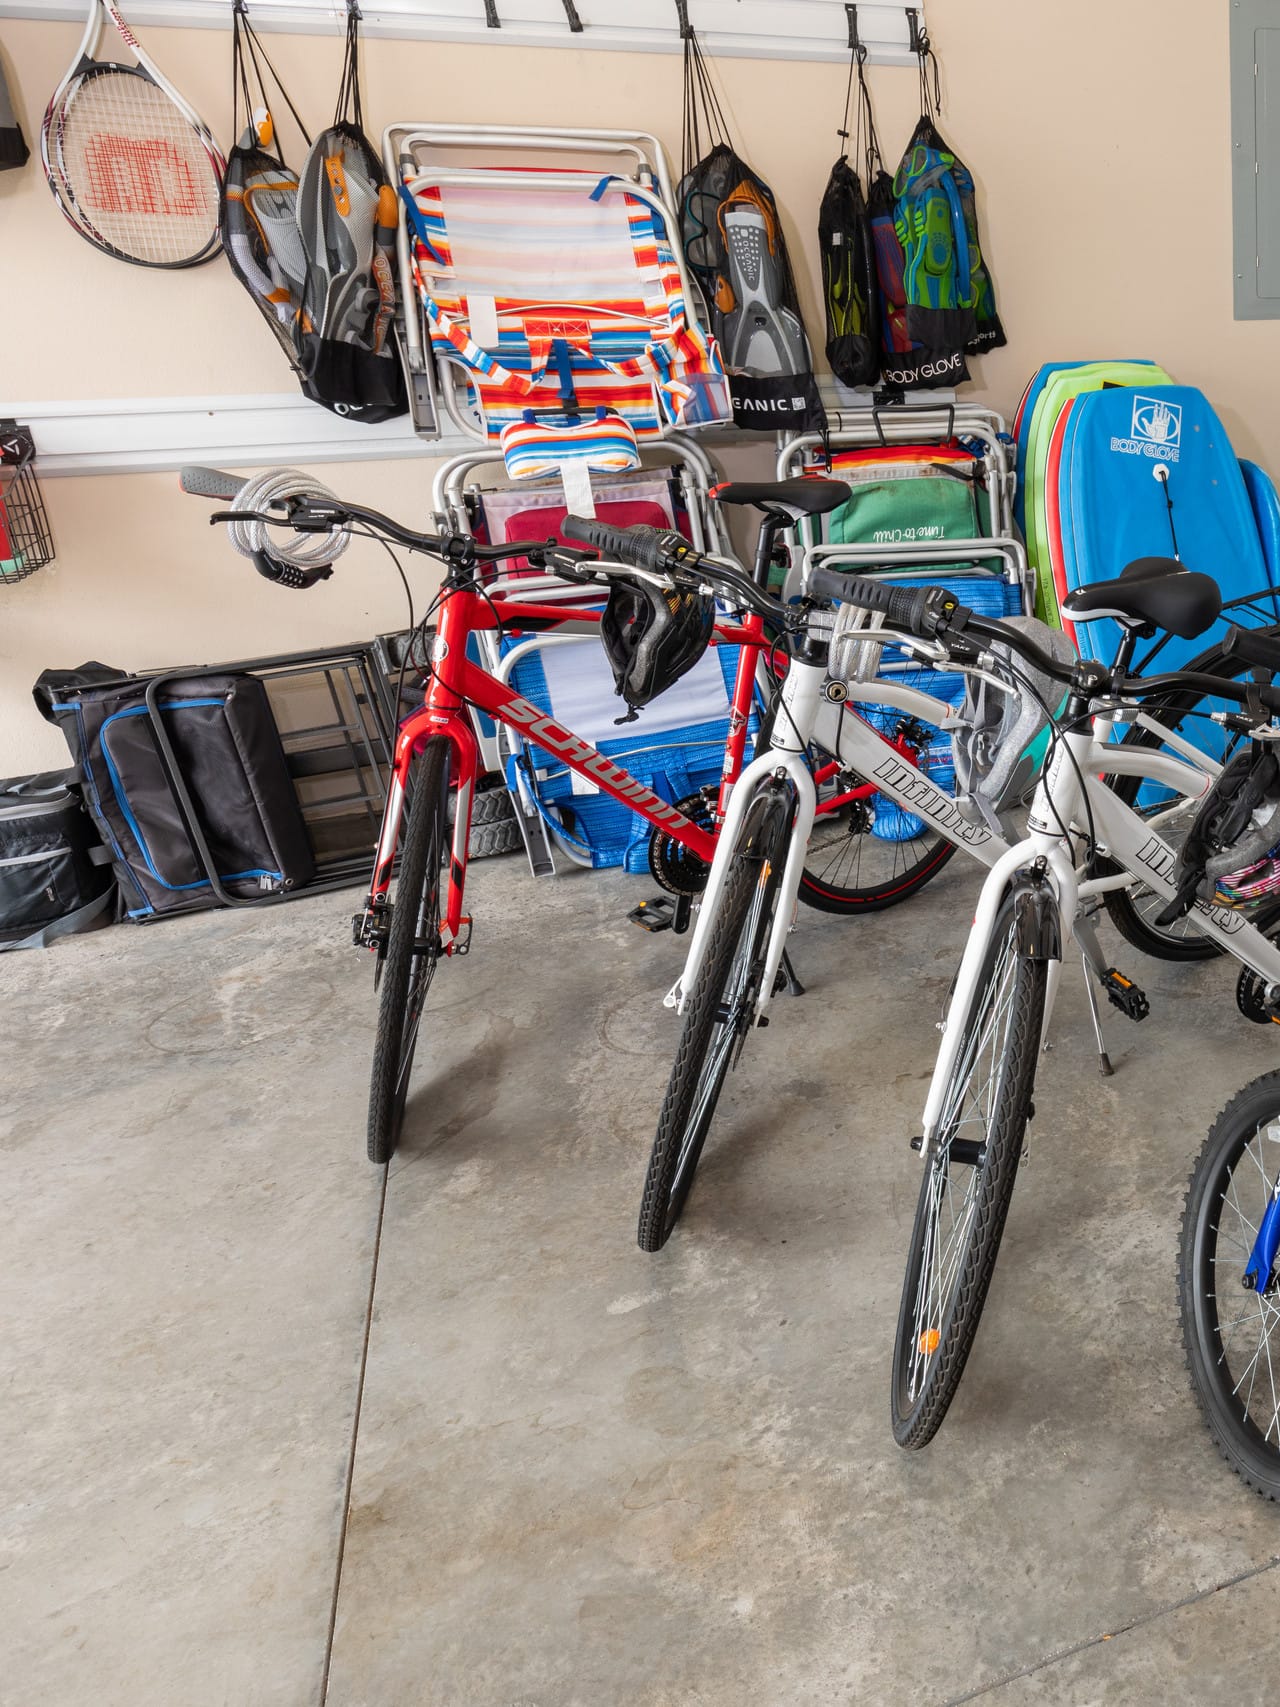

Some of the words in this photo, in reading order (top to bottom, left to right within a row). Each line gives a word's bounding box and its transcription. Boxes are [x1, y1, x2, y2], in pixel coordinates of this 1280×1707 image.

[920, 353, 962, 378] GLOVE
[1110, 437, 1145, 456] BODY
[1143, 443, 1180, 462] GLOVE
